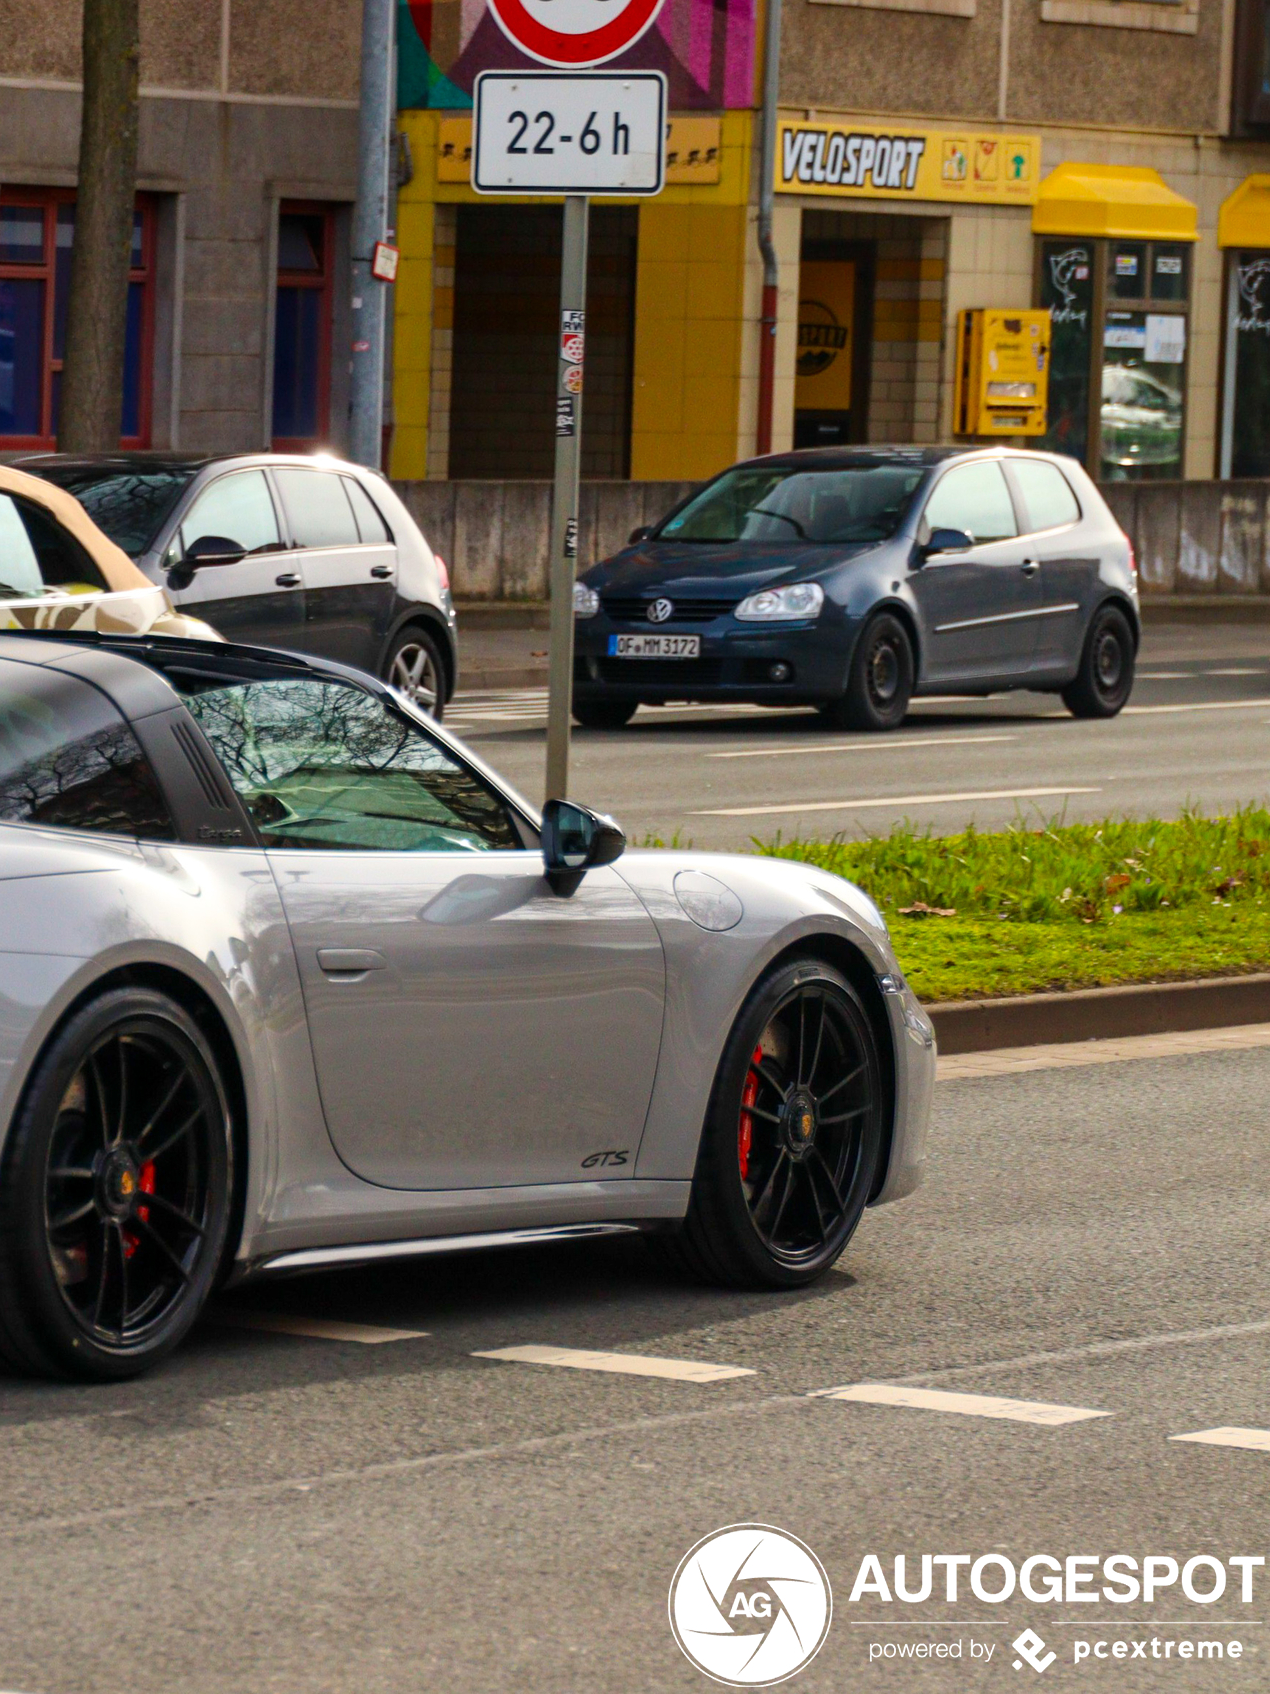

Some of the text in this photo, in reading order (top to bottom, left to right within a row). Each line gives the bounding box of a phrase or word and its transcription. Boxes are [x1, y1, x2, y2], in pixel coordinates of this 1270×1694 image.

[507, 111, 630, 155] 22-6 h
[783, 128, 926, 189] VELOSPORT
[663, 639, 697, 655] 3172
[581, 1150, 630, 1168] GTS
